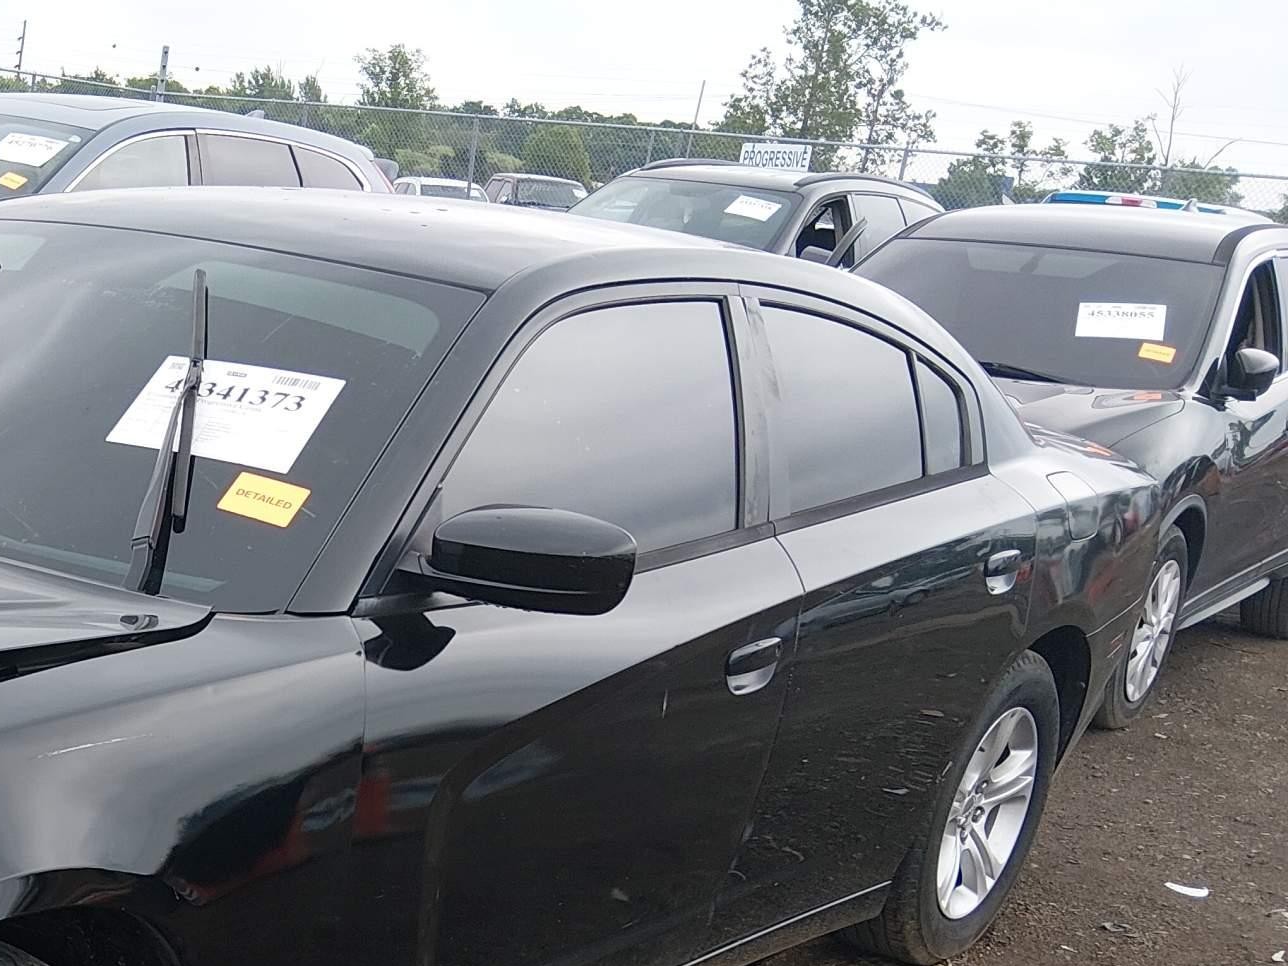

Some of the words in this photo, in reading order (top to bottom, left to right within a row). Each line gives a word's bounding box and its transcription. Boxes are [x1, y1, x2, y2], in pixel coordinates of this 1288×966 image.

[743, 150, 808, 167] PROGRESSIVE
[165, 378, 306, 412] 4341373
[235, 488, 293, 510] DETAILED
